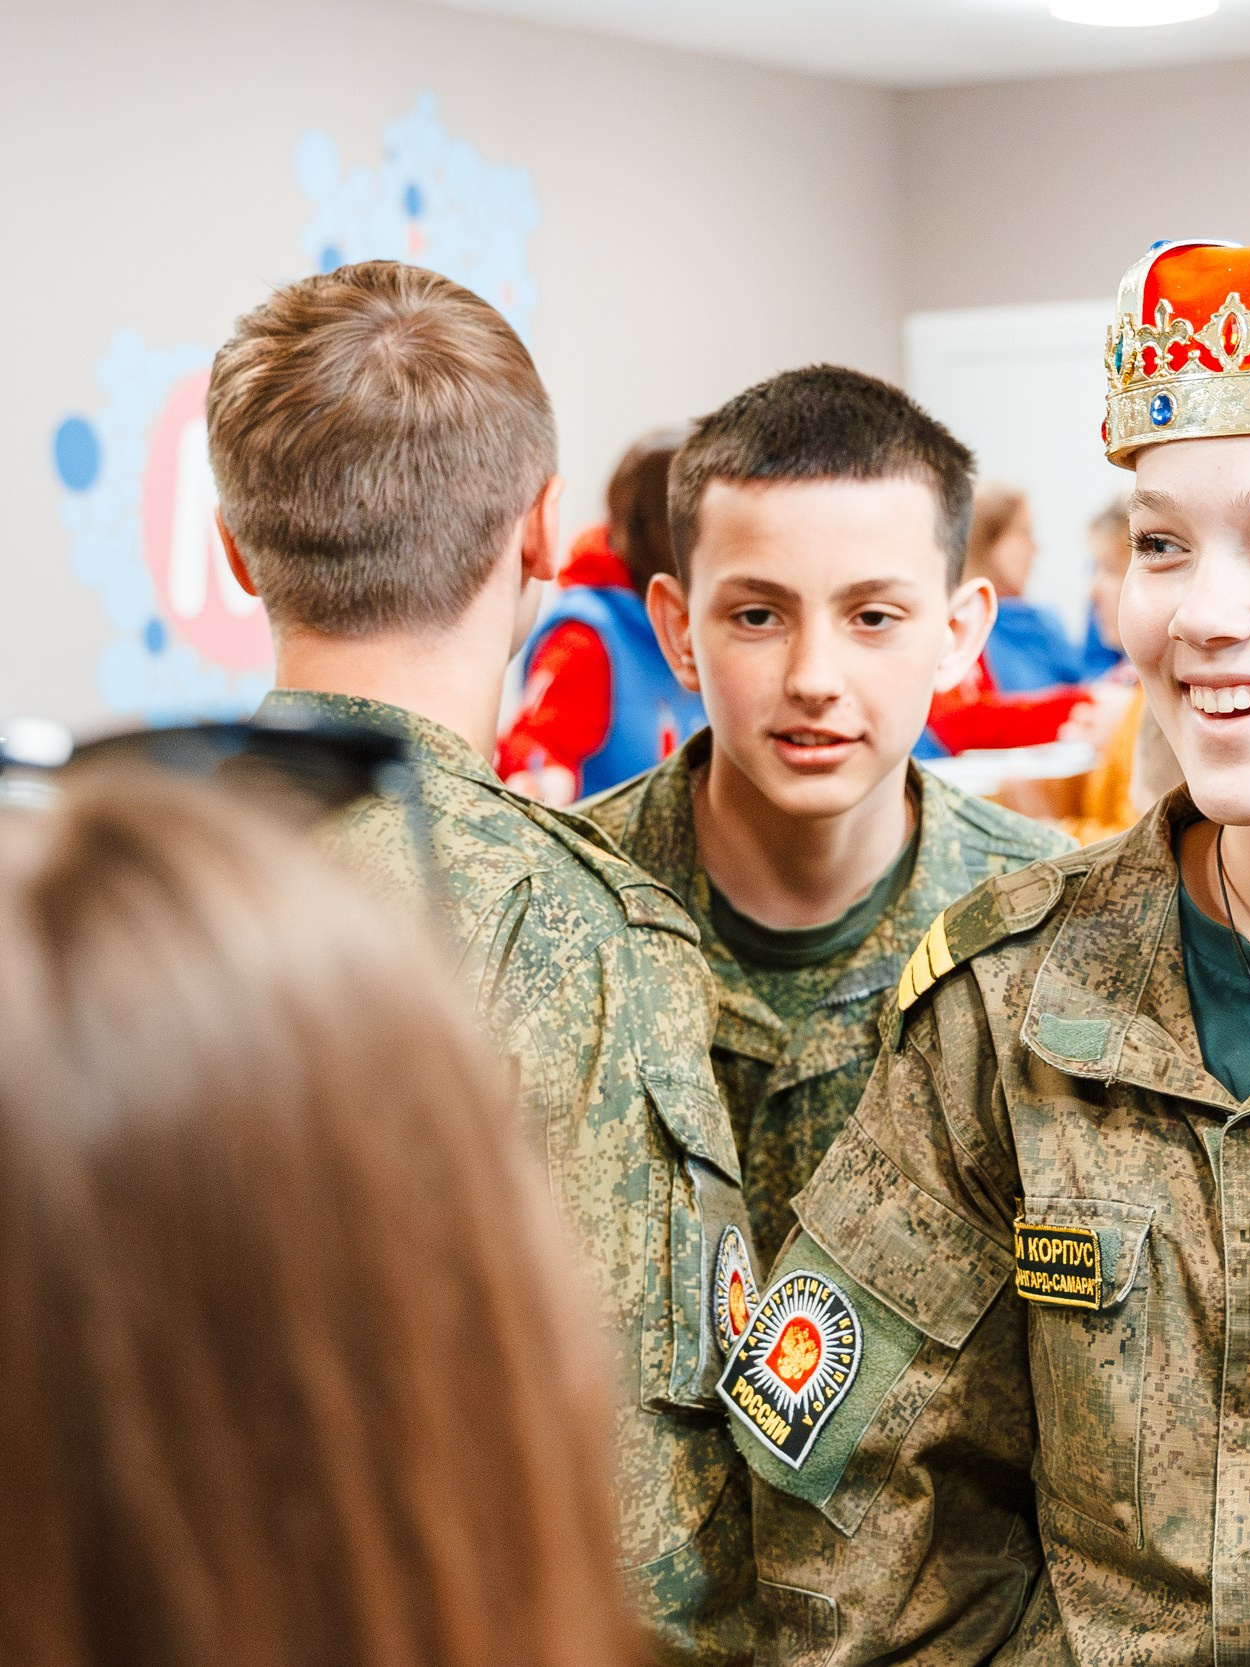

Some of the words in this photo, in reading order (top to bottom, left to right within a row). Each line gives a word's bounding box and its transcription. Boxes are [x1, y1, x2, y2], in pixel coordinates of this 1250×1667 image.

[1028, 1237, 1094, 1268] КОРПУС
[802, 1317, 854, 1427] КОРПУСА
[731, 1375, 792, 1446] РОССИИ
